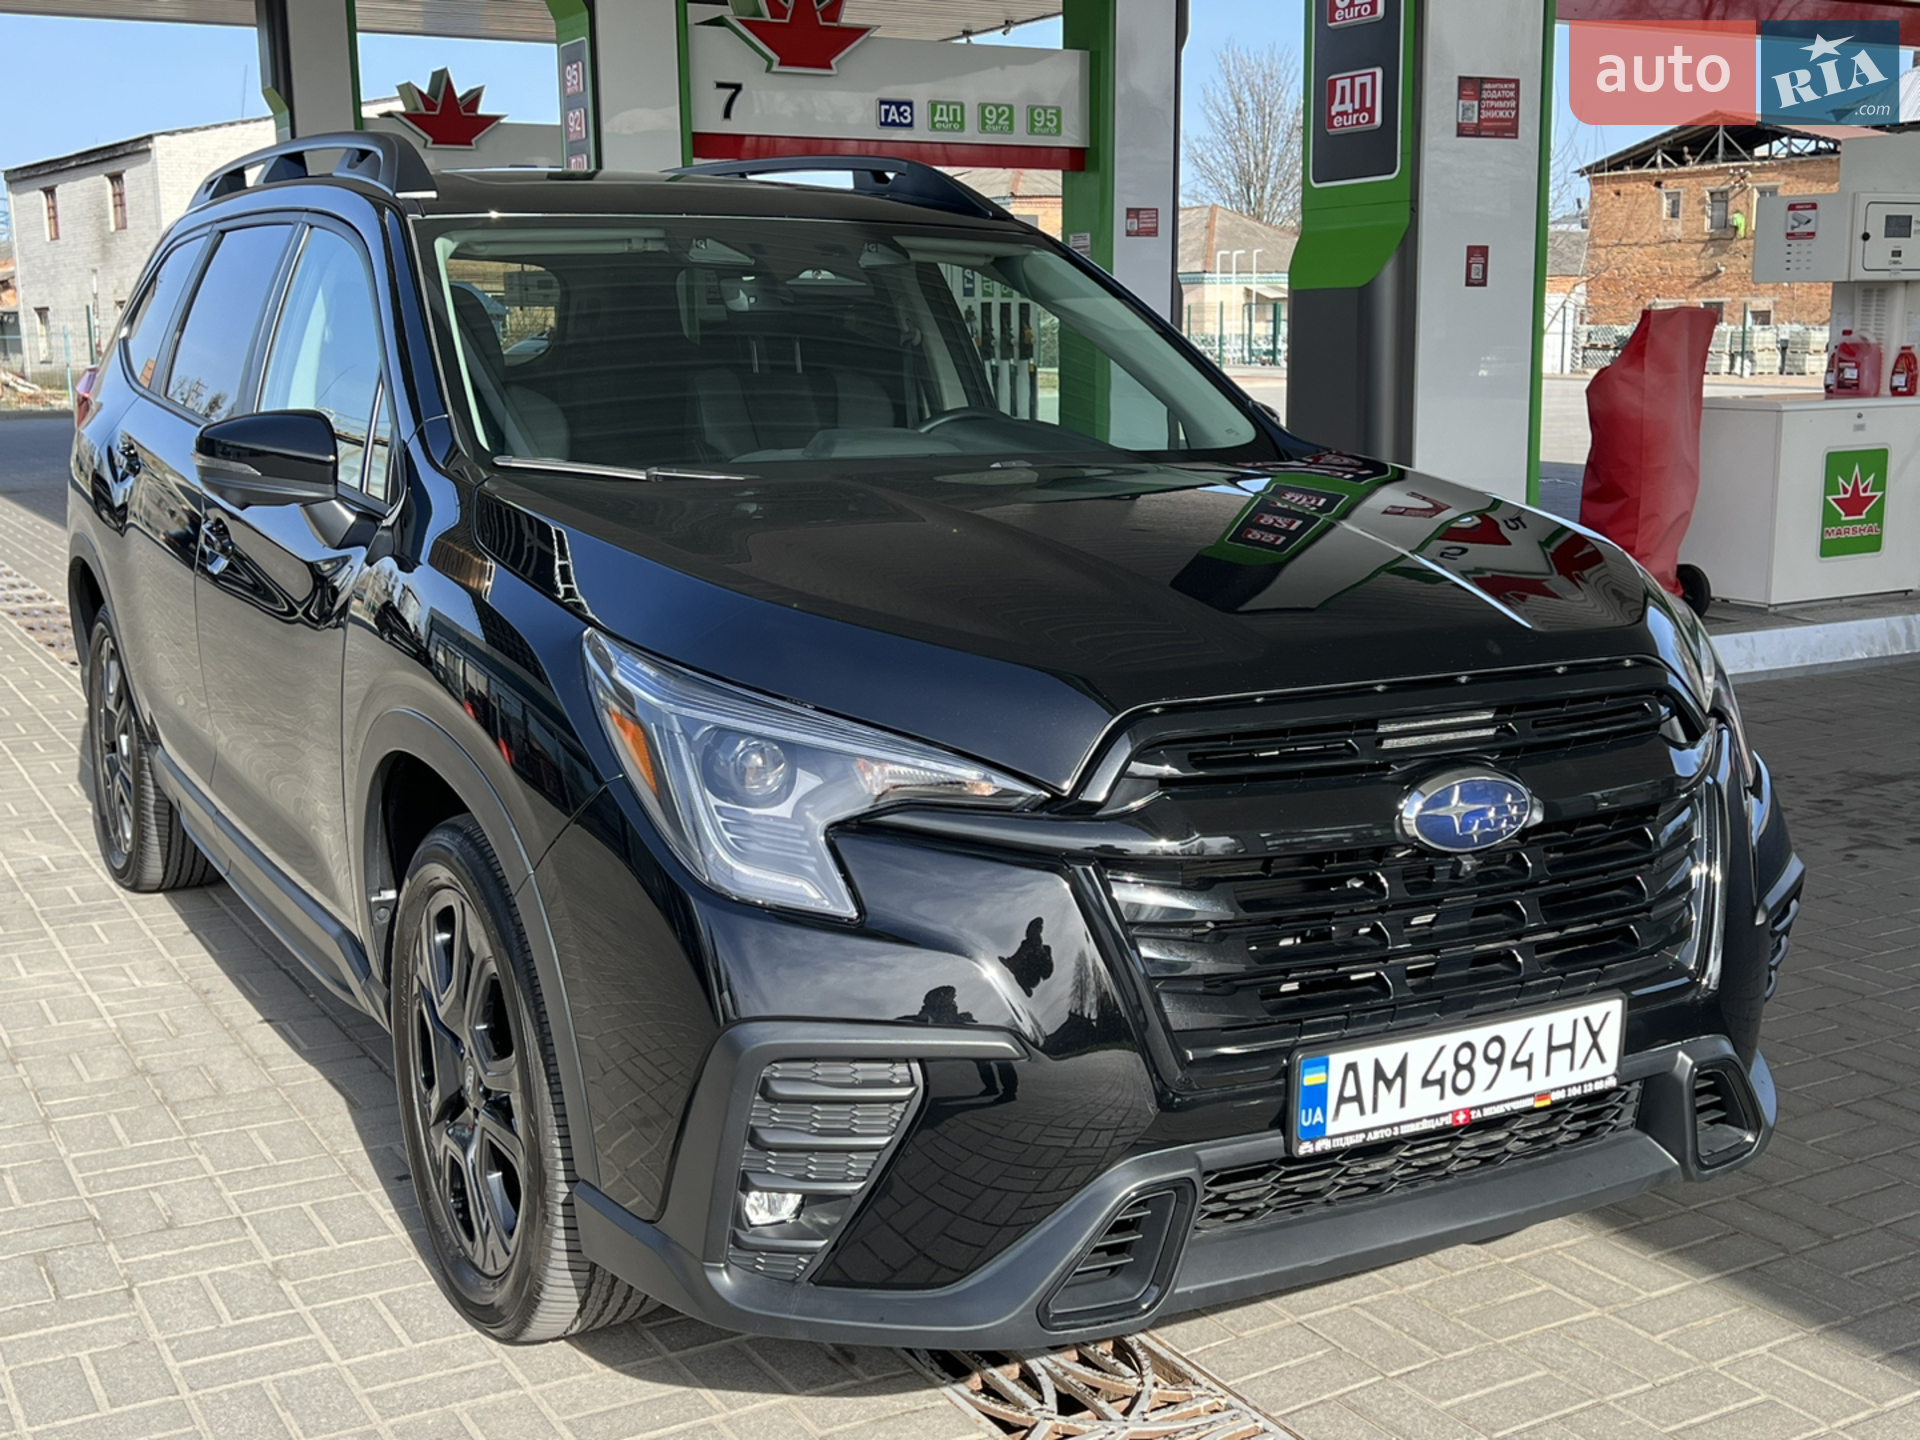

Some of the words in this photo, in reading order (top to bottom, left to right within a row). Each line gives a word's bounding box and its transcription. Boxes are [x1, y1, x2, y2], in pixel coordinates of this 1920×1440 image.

[1335, 4, 1371, 21] euro
[566, 64, 579, 87] 95
[714, 81, 743, 121] 7
[1330, 75, 1372, 116] ДП
[1481, 90, 1516, 99] ДОДАТОК
[568, 111, 582, 133] 92
[880, 104, 912, 124] ГАЗ
[933, 104, 962, 123] ДП
[984, 105, 1010, 125] 92
[1033, 107, 1058, 128] 95
[1333, 111, 1370, 127] euro
[1480, 109, 1517, 119] ЗНИЖКУ
[935, 122, 961, 130] euro
[1824, 523, 1881, 539] MARSHAL
[1332, 1051, 1408, 1122] AM
[1421, 1027, 1535, 1101] 4894
[1545, 1011, 1612, 1078] HX
[1301, 1106, 1325, 1127] UA
[1366, 1127, 1393, 1142] АВТО
